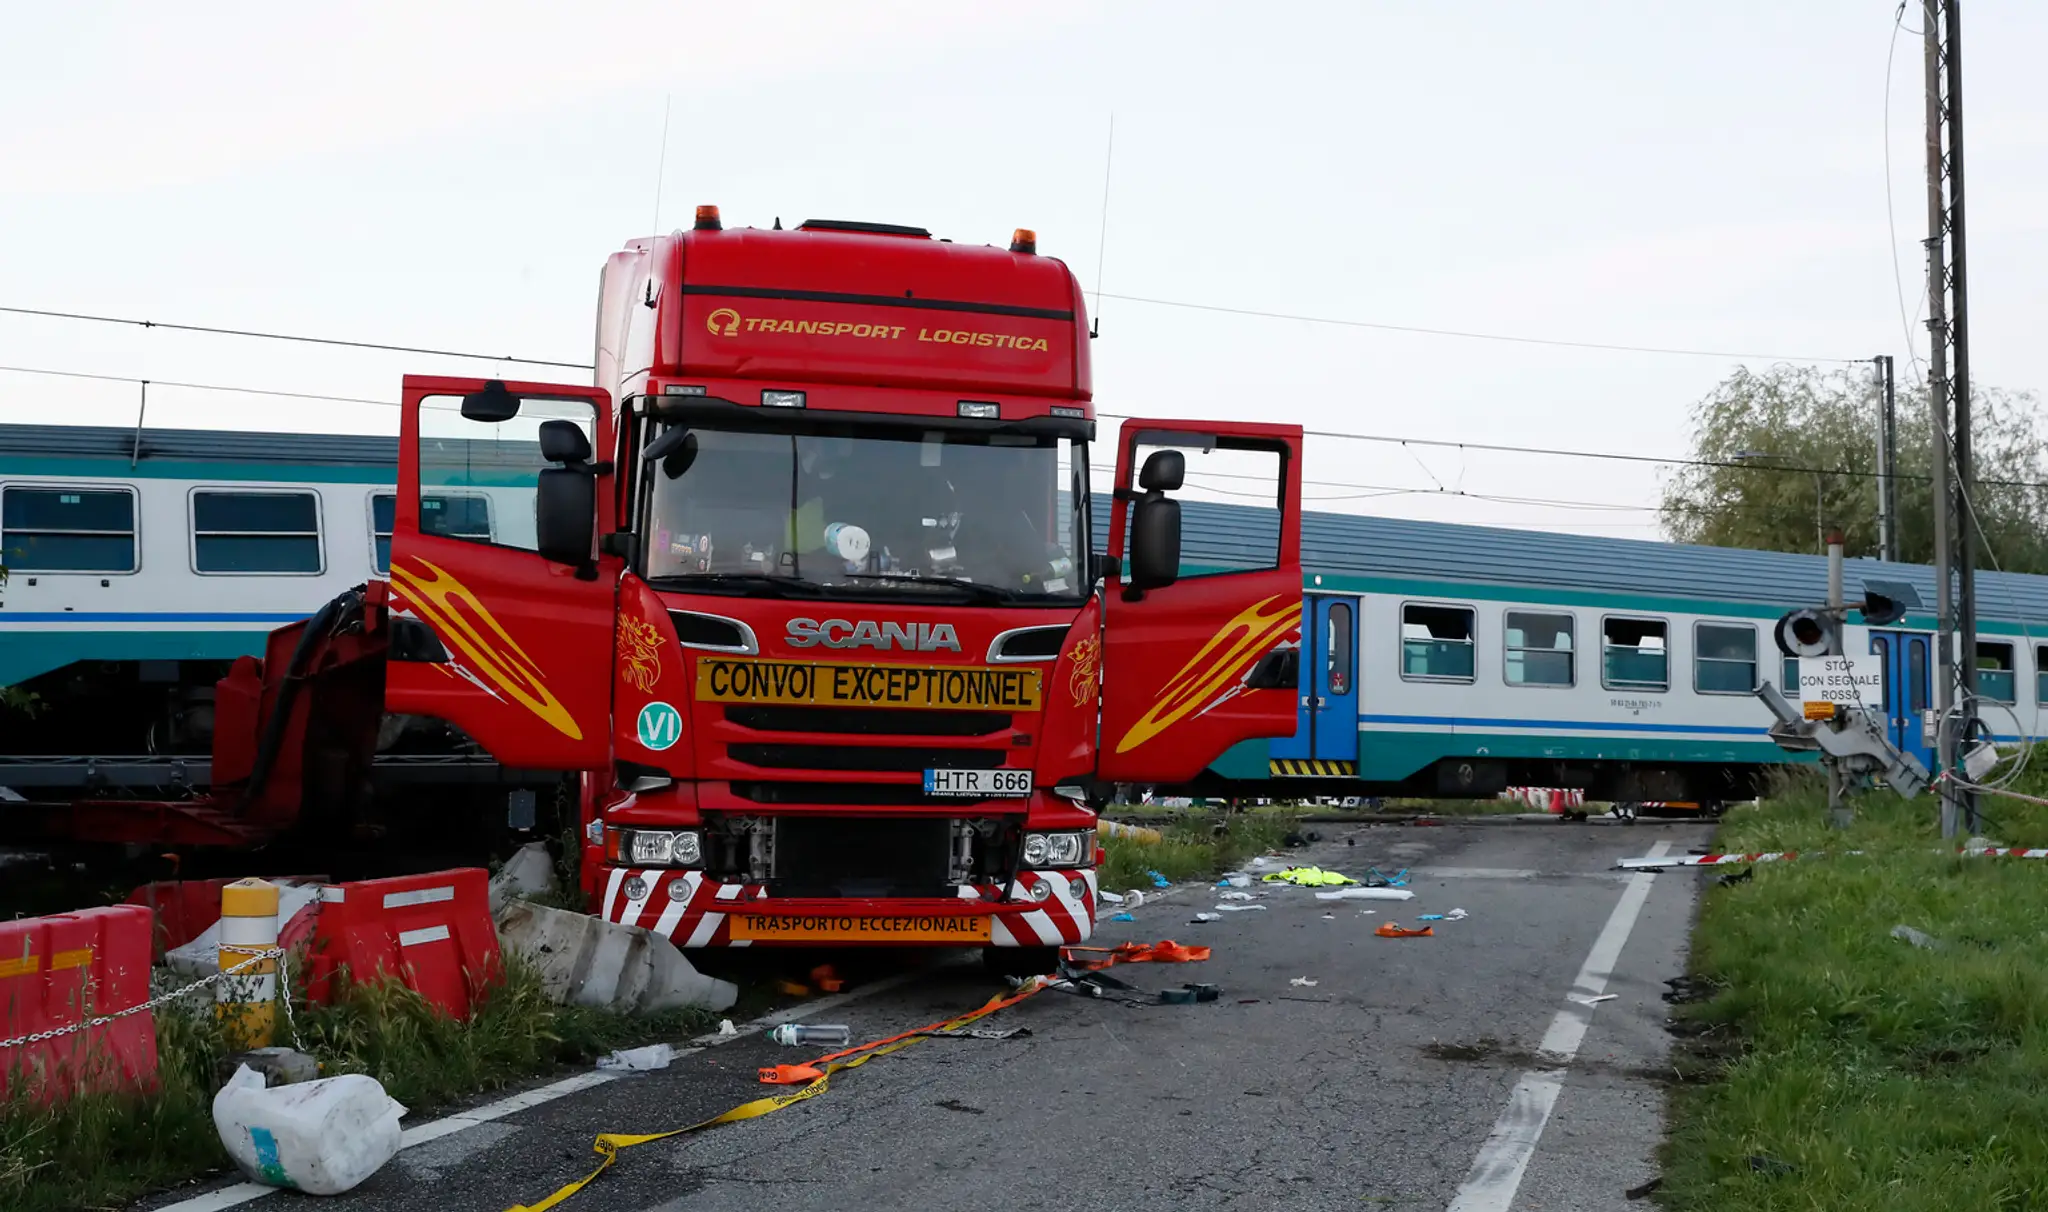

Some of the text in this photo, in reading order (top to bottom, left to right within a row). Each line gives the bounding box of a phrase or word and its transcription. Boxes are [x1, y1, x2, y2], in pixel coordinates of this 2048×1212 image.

[745, 317, 1048, 352] TRANSPORT LOGISTICA
[785, 618, 961, 651] SCANIA
[1825, 660, 1855, 671] STOP
[710, 662, 1032, 706] CONVOI EXCEPTIONNEL
[1800, 674, 1880, 687] CON SEGNALE
[1821, 689, 1861, 700] ROSSO
[644, 710, 674, 741] VI
[936, 771, 1029, 791] HTR 666
[746, 916, 979, 932] TRASPORTO ECCEZIONALE
